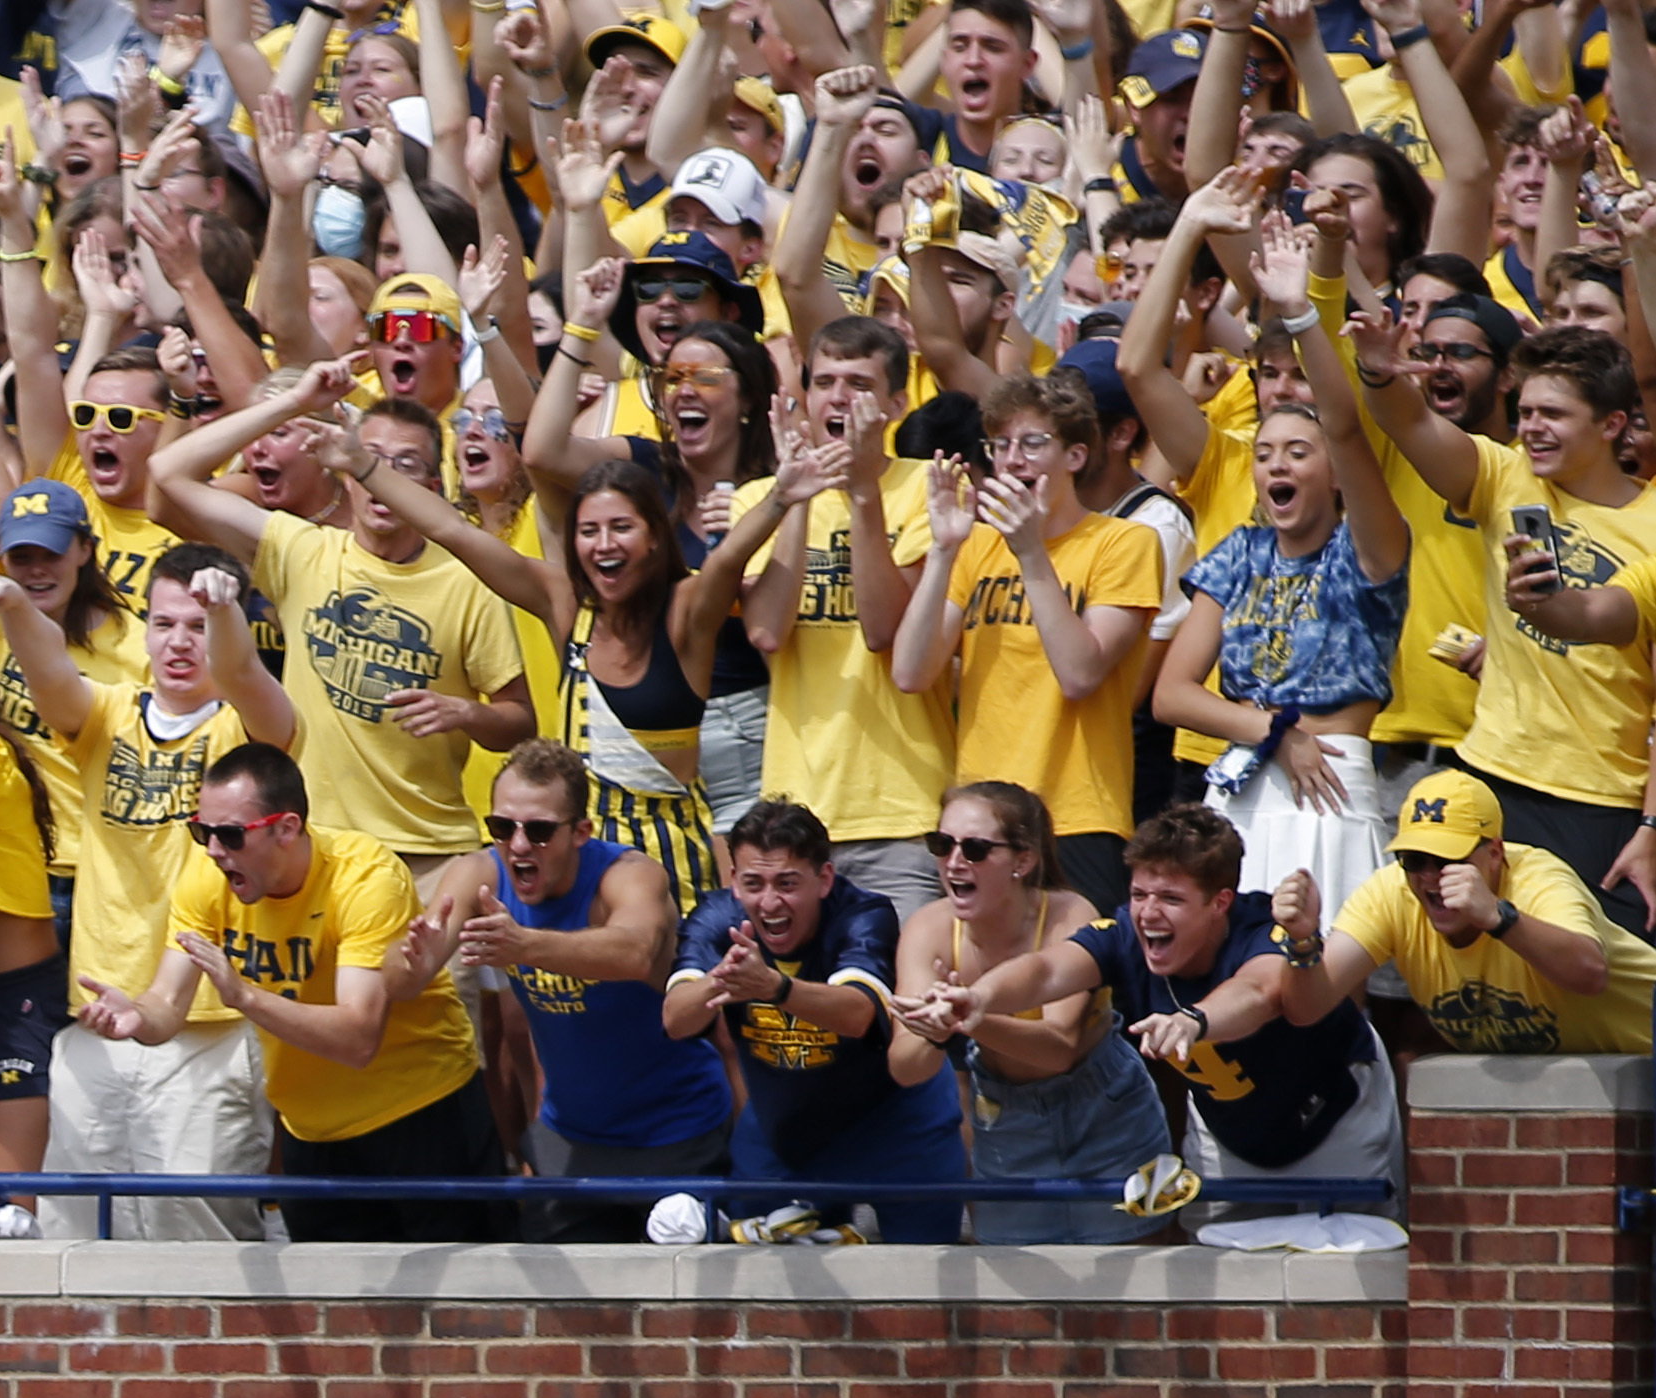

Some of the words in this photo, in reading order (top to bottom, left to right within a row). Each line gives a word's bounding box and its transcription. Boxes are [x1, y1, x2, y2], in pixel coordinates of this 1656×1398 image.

[12, 493, 49, 518] M
[302, 610, 441, 676] MICHIGAN
[330, 691, 373, 718] 2019
[1409, 798, 1448, 824] M
[1, 1069, 21, 1084] M
